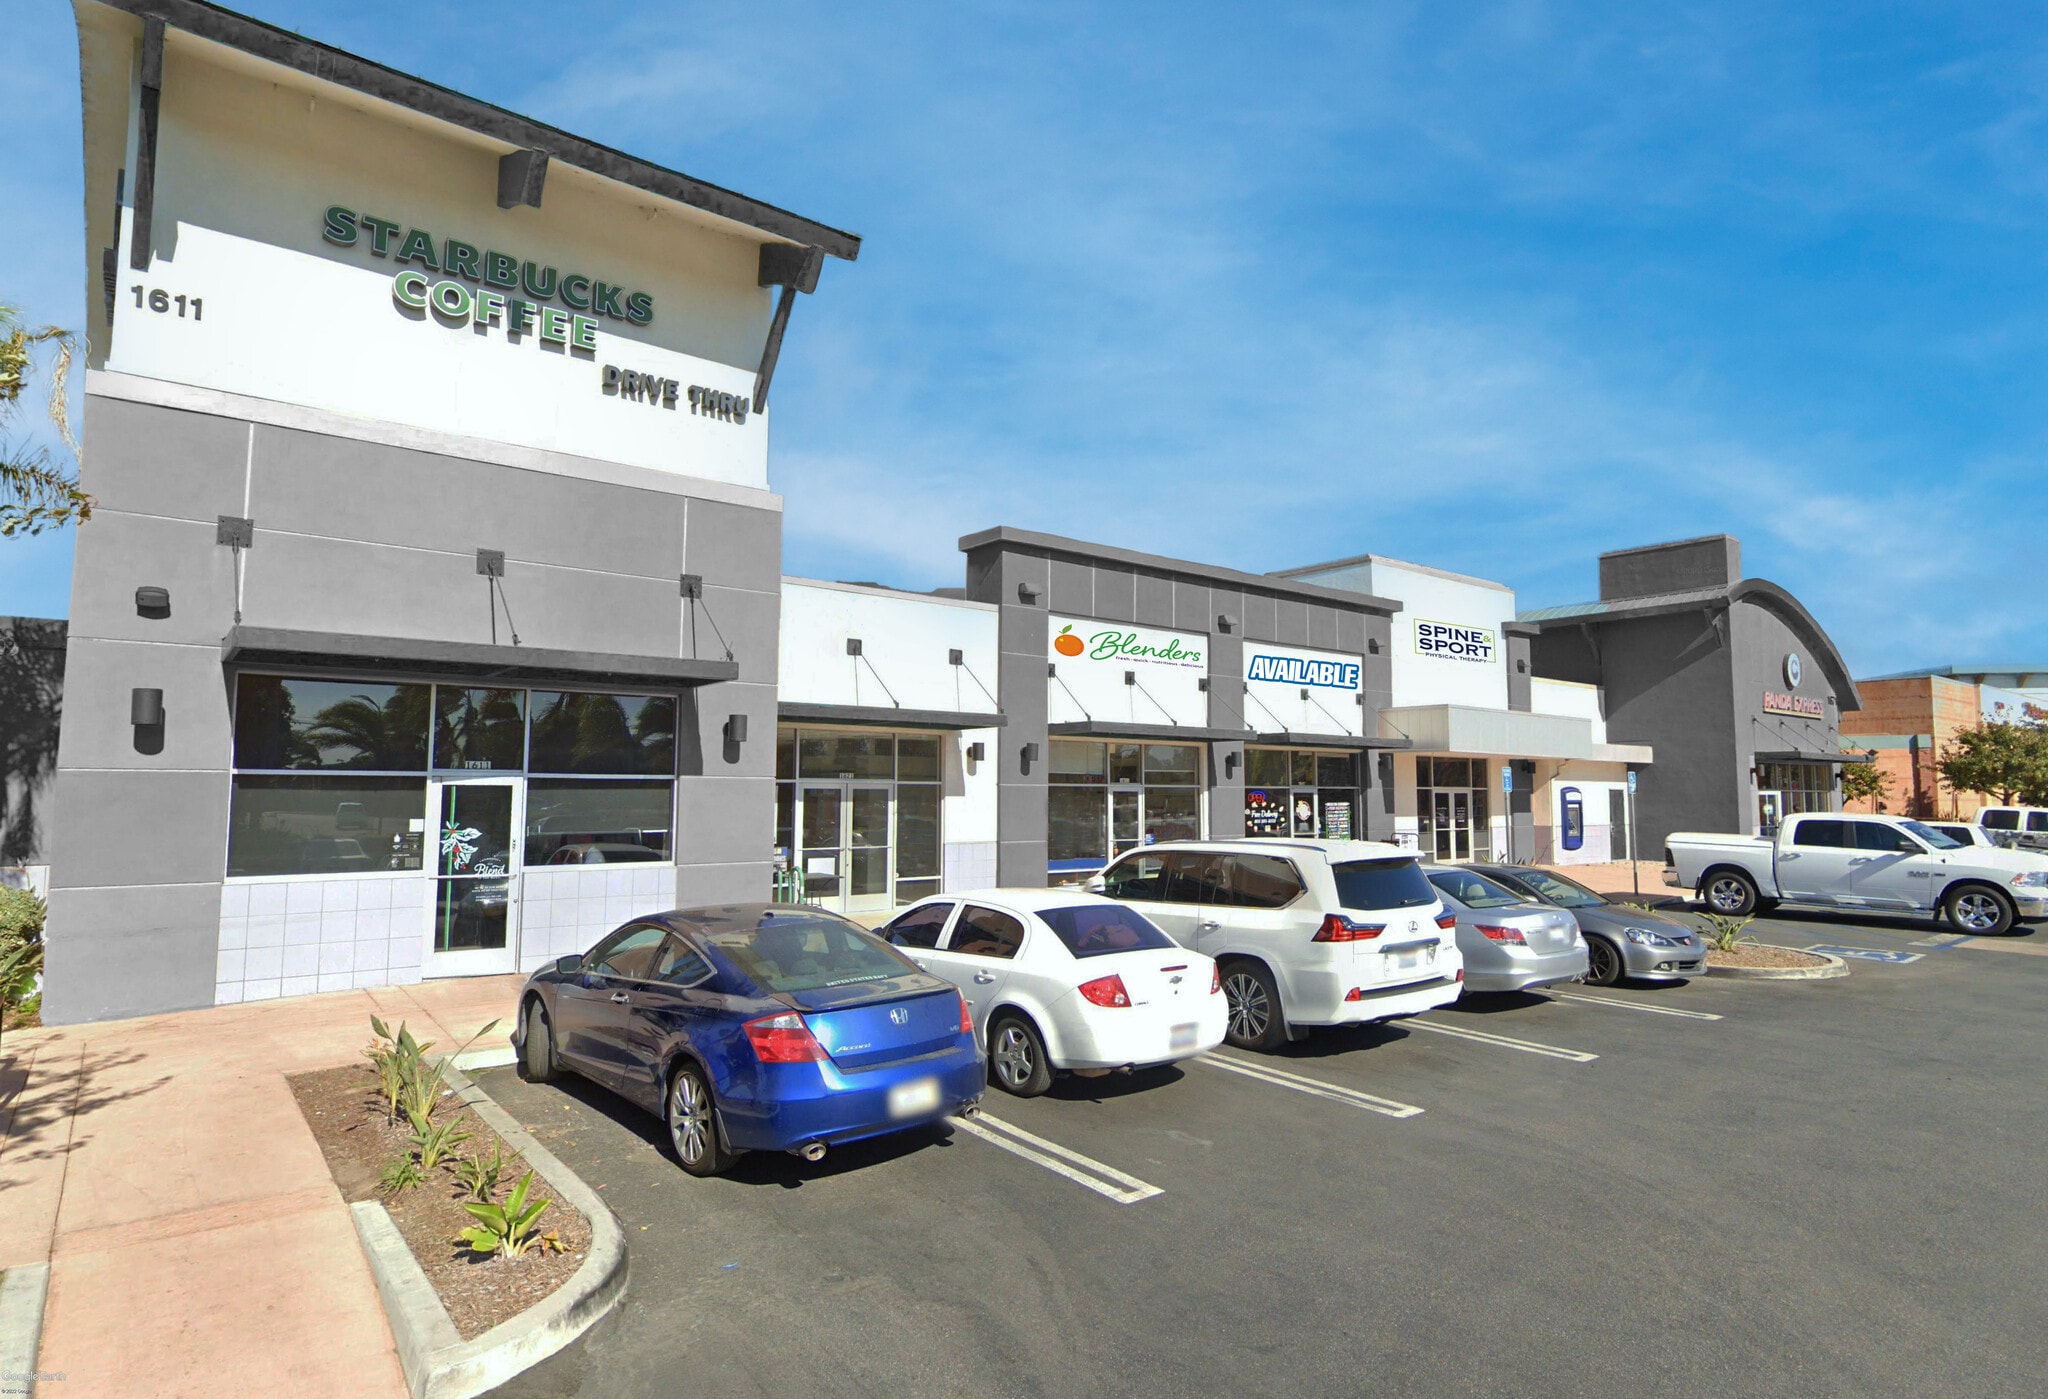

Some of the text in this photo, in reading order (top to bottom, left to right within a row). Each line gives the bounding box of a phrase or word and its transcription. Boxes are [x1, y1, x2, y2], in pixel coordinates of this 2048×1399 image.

[323, 204, 655, 325] STARBUCKS
[131, 285, 203, 321] 1611
[393, 271, 599, 352] COFFEE
[602, 364, 750, 416] DRIVE THRU
[1089, 631, 1201, 662] Blenders
[1418, 624, 1484, 644] SPINE
[1419, 638, 1492, 657] SPORT
[1425, 652, 1457, 660] PHYSICAL
[1248, 655, 1360, 690] AVAILABLE
[1763, 691, 1792, 711] PANDA
[1793, 696, 1824, 715] EXPRESS
[465, 760, 492, 769] 1611
